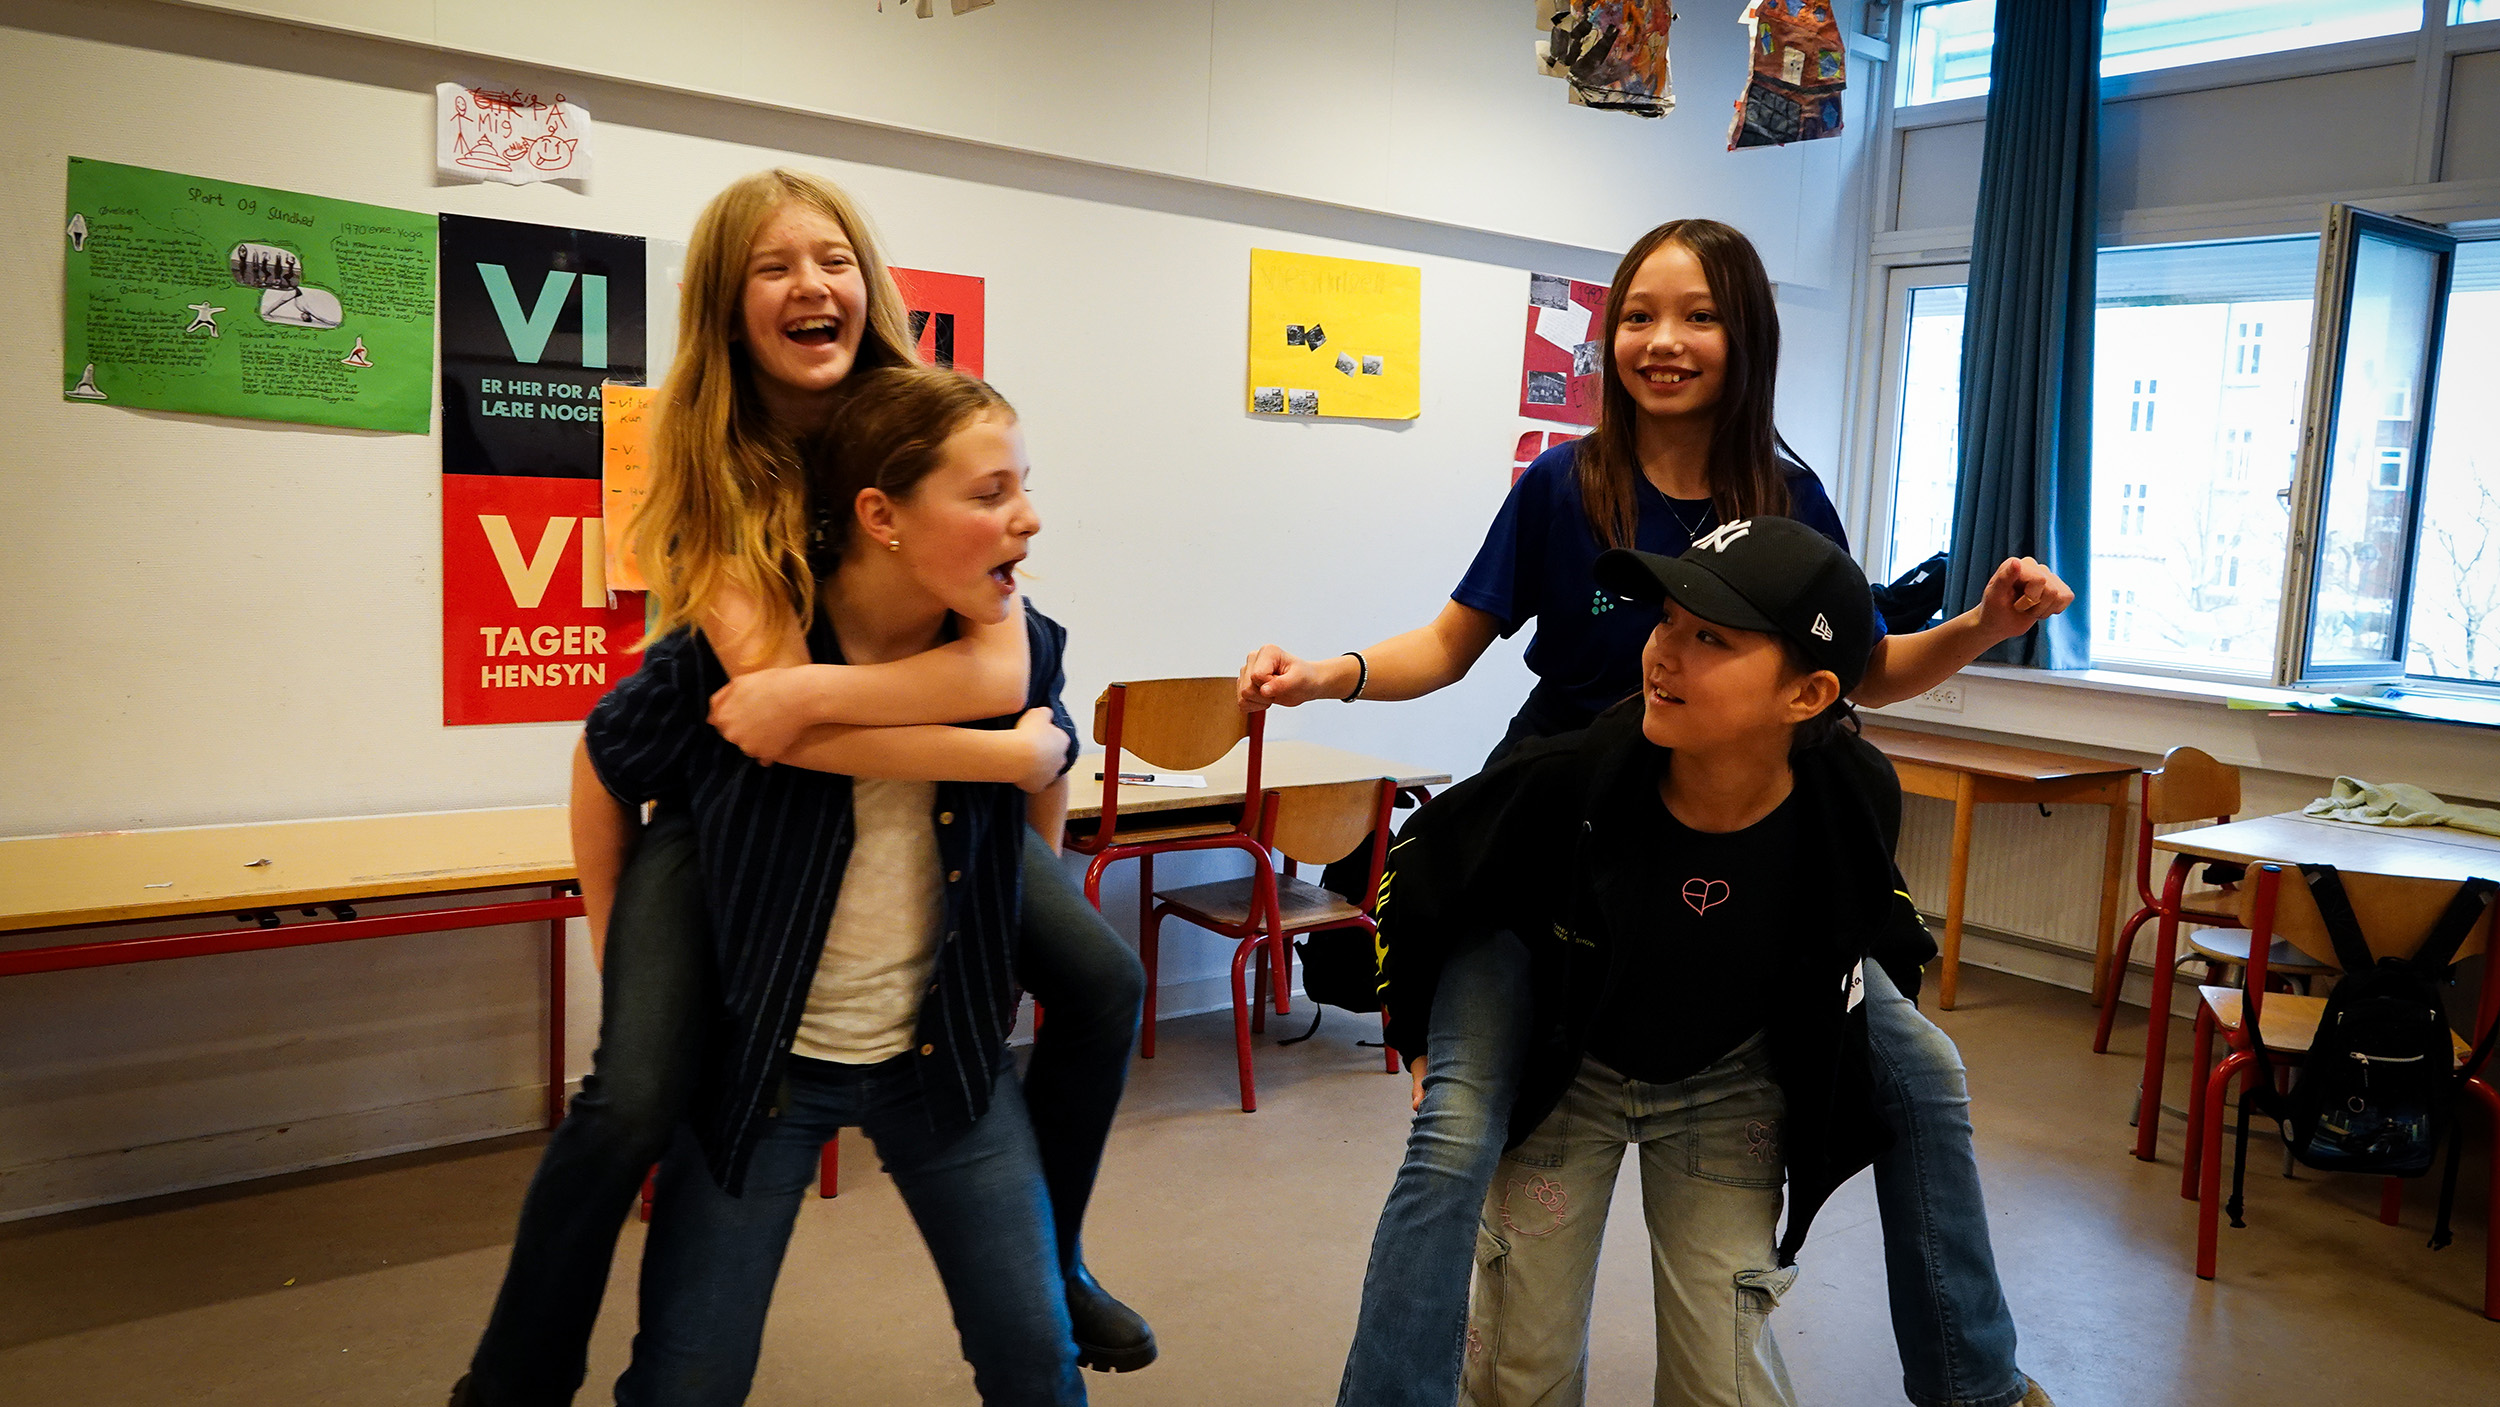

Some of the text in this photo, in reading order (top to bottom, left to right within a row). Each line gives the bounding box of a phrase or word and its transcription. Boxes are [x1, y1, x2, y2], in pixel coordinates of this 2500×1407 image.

[479, 112, 512, 138] Mig
[476, 262, 608, 369] VI
[481, 378, 503, 394] ER
[508, 381, 543, 396] HER
[548, 384, 583, 399] FOR
[481, 400, 534, 418] LÆRE
[477, 514, 607, 608] VI
[480, 626, 608, 657] TAGER
[481, 663, 605, 689] HENSYN
